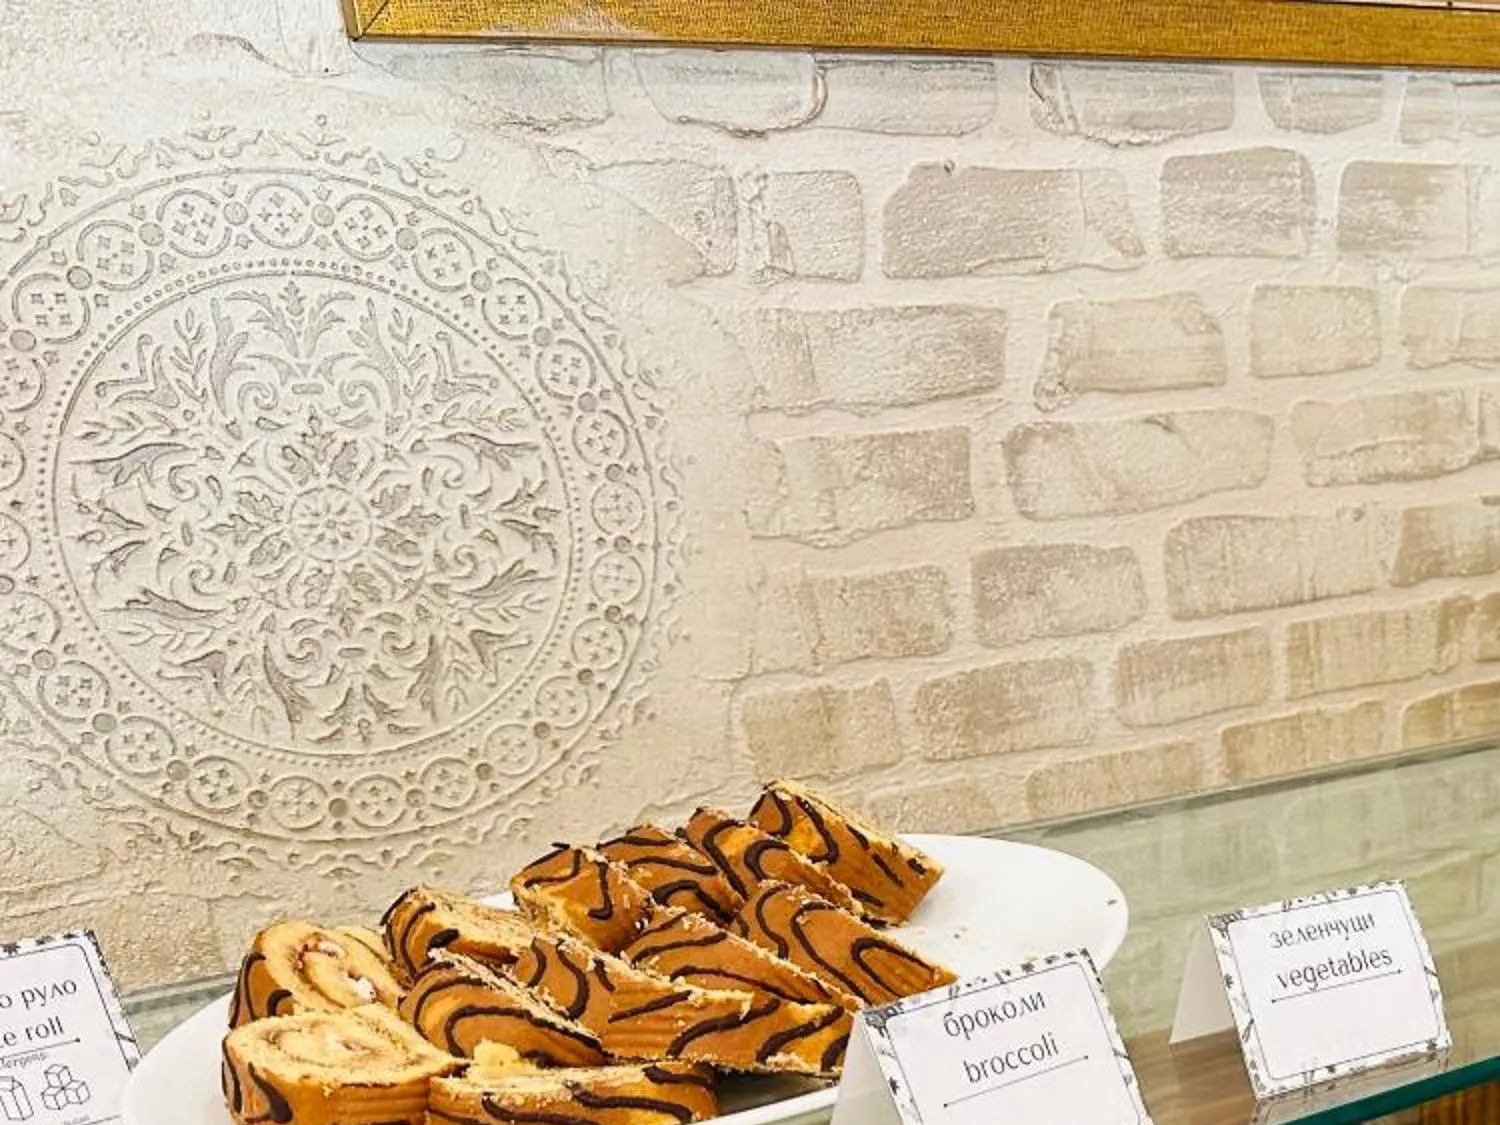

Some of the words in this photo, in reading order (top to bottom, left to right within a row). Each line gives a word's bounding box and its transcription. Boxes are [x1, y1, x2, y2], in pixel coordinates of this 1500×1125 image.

[1269, 912, 1376, 949] зеленчуци
[1277, 948, 1393, 990] vegetables
[21, 979, 78, 1010] руло
[25, 1016, 64, 1041] roll
[943, 992, 1047, 1041] броколи
[963, 1032, 1059, 1083] broccoli
